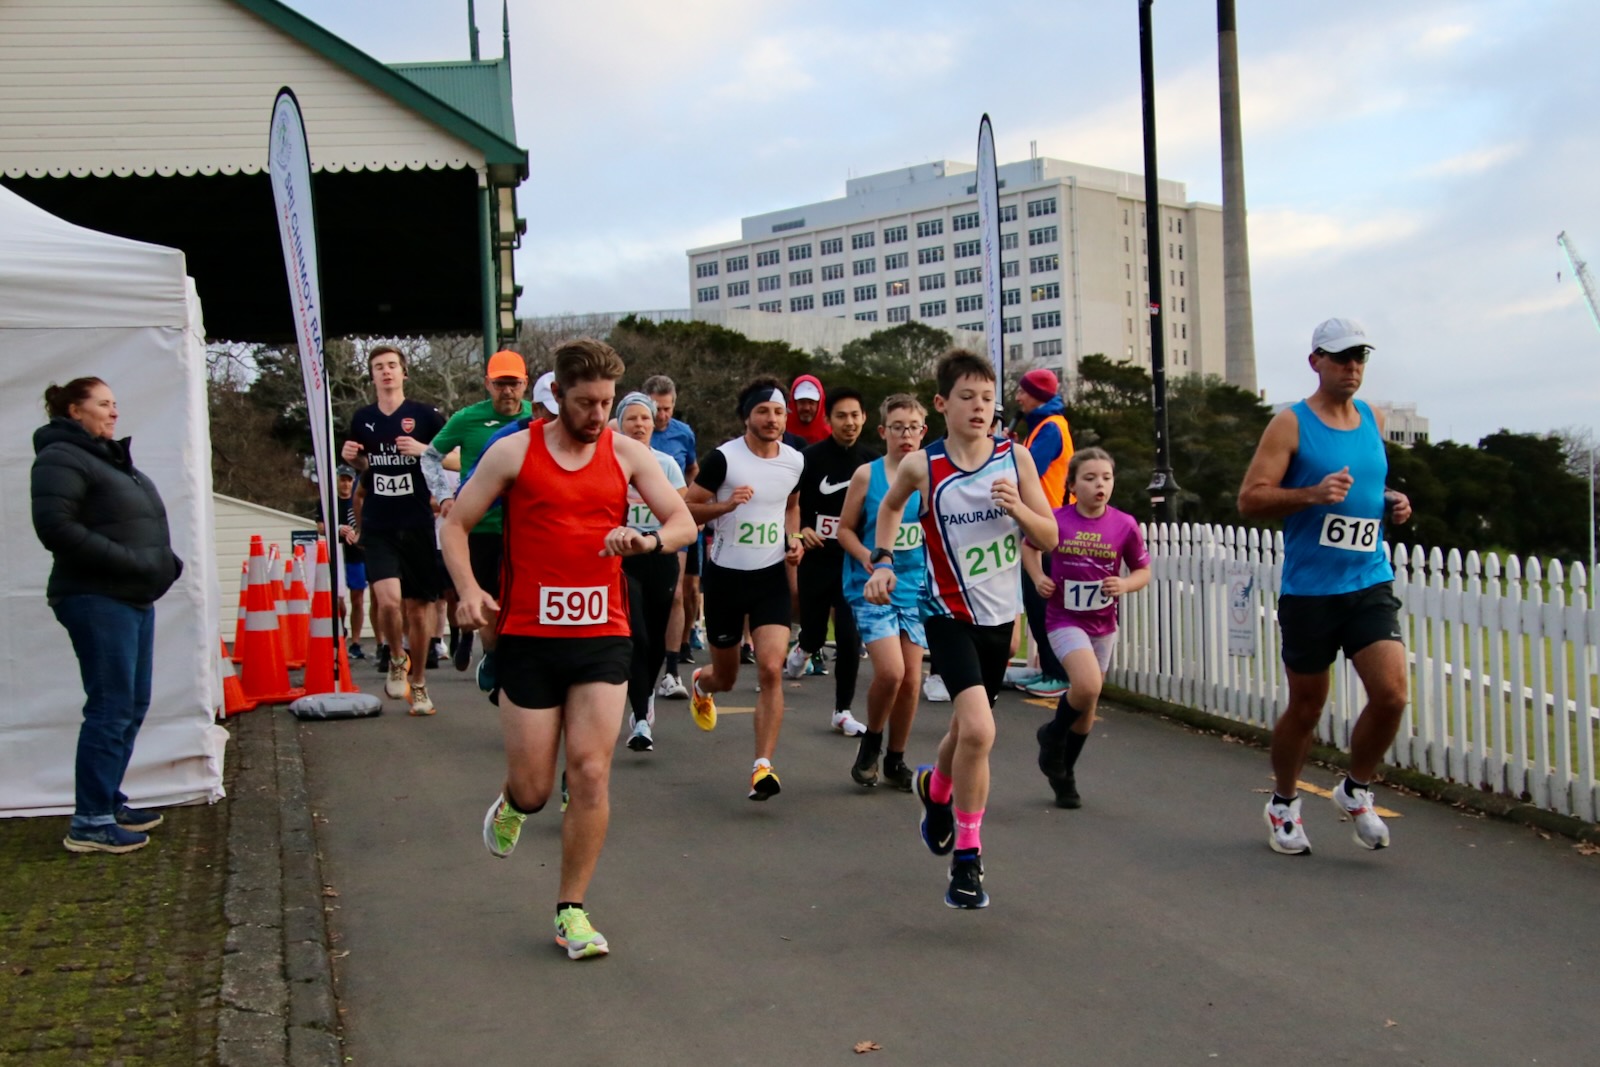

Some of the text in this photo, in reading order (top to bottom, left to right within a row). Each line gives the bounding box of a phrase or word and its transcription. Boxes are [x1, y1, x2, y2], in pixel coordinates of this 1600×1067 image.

[285, 171, 295, 210] SRI
[292, 212, 314, 312] CHINMOY
[367, 452, 417, 466] Emirates
[376, 476, 411, 493] 644
[738, 522, 778, 545] 216
[1075, 531, 1102, 542] 2021
[1326, 518, 1375, 547] 618
[1058, 546, 1117, 559] MARATHON
[1063, 539, 1112, 550] HUNTLY HALF
[965, 534, 1017, 577] 218
[545, 590, 603, 622] 590
